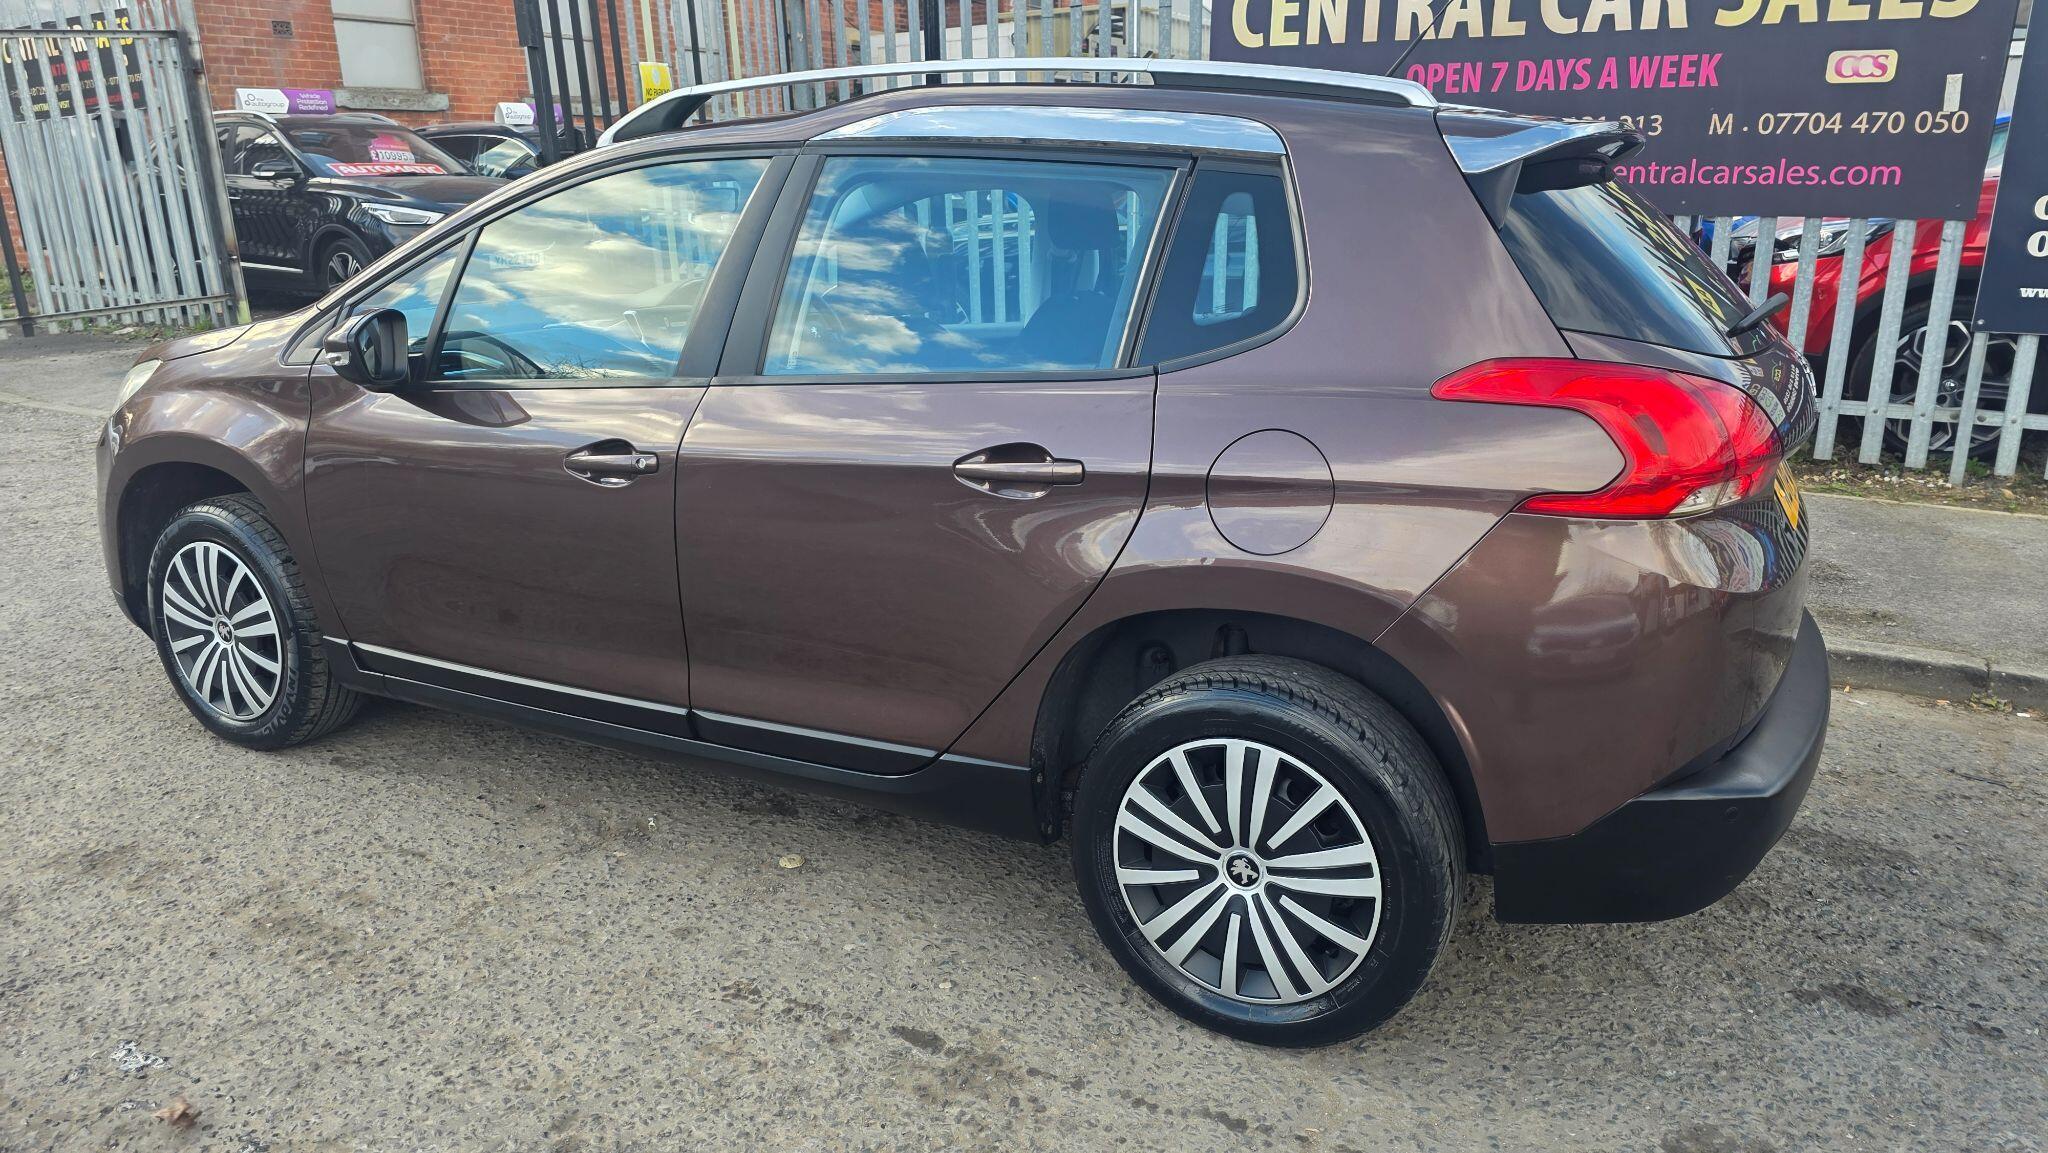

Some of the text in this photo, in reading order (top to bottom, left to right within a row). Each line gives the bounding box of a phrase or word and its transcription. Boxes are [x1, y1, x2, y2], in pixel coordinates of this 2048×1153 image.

[1407, 52, 1724, 94] OPEN 7 DAYS A WEEK
[1833, 54, 1890, 79] CCS
[1758, 112, 1843, 135] 07704
[1851, 111, 1906, 134] 470
[1914, 110, 1970, 134] 050
[338, 164, 443, 176] AUTOMATIC
